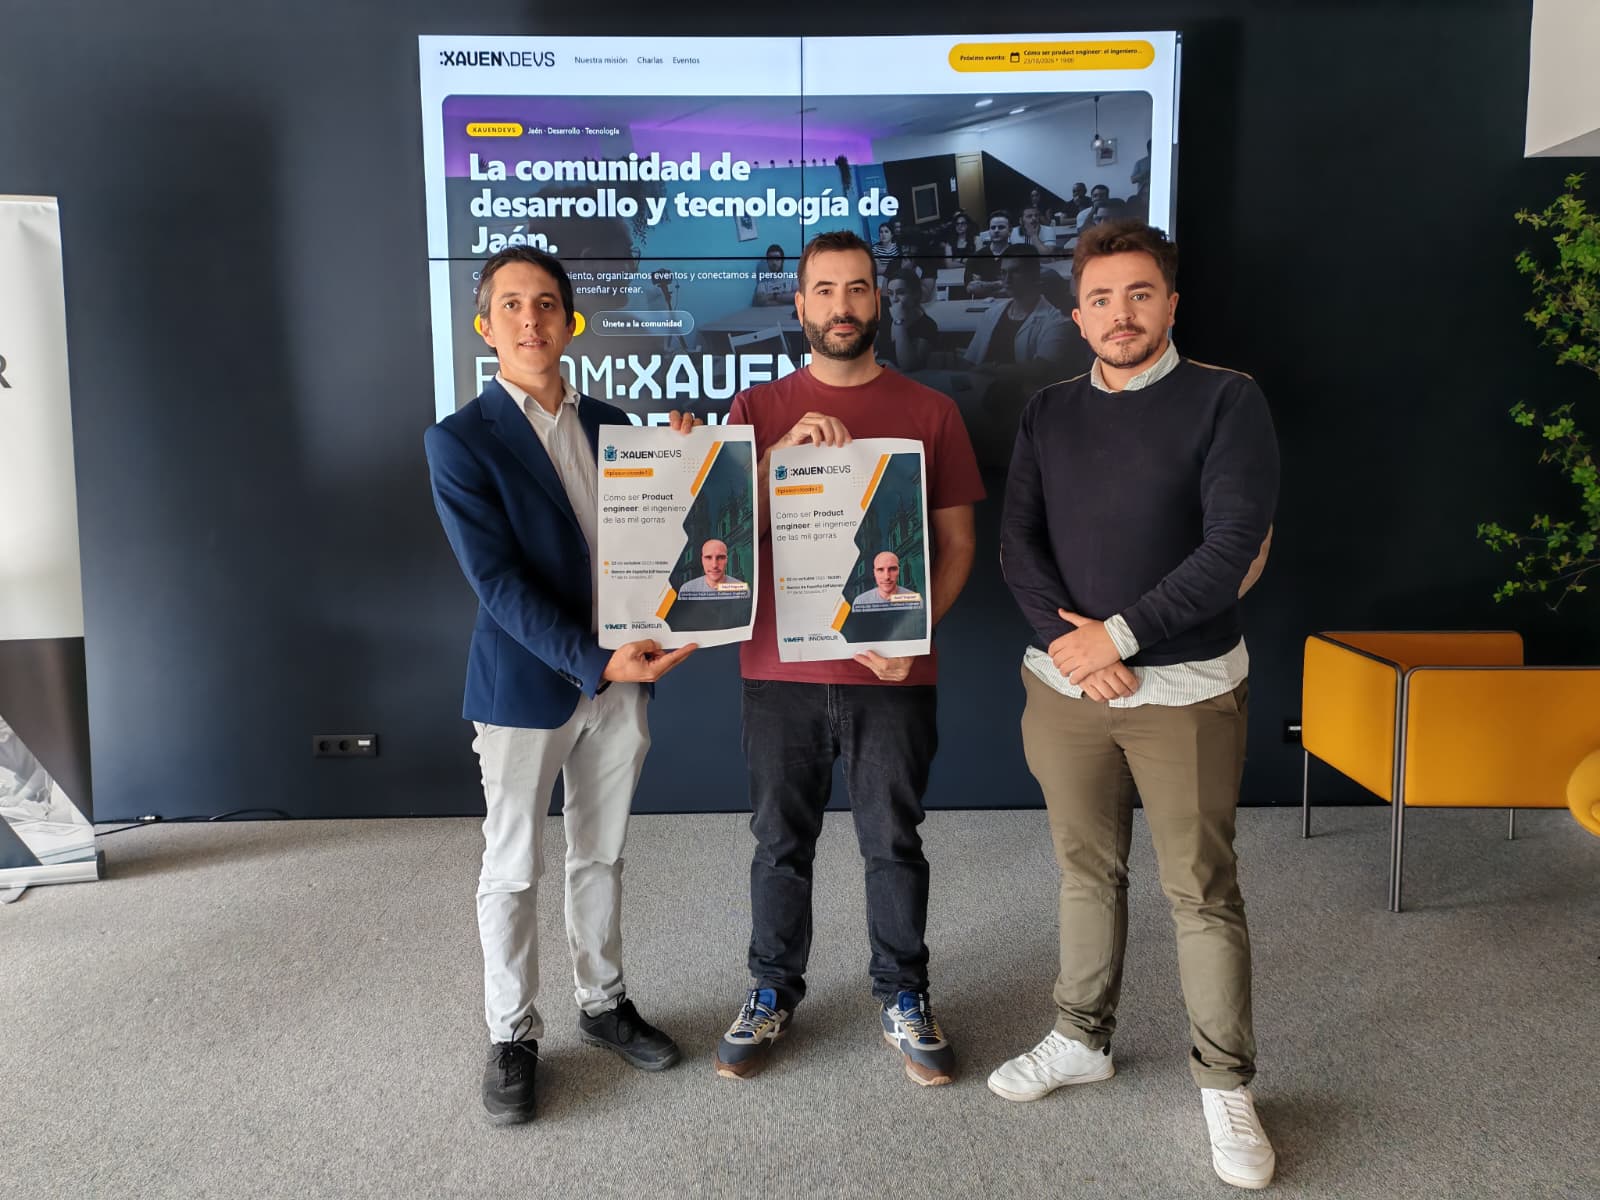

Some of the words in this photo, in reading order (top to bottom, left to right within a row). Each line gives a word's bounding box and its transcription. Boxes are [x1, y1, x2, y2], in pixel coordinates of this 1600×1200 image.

[574, 56, 603, 64] Nuestra
[604, 56, 628, 64] misión
[637, 56, 664, 64] Charlas
[672, 56, 700, 64] Eventos
[547, 127, 580, 135] Desarrollo
[585, 127, 620, 136] Tecnología
[469, 153, 506, 181] La
[515, 152, 701, 182] comunidad
[709, 152, 751, 181] de
[470, 188, 638, 218] desarrollo
[646, 196, 668, 226] y
[675, 188, 849, 225] tecnología
[858, 188, 899, 217] de
[597, 271, 652, 282] organizamos
[654, 272, 688, 280] eventos
[690, 273, 695, 282] y
[698, 271, 749, 280] conectamos
[759, 272, 798, 282] personas
[576, 285, 610, 294] enseñar
[612, 286, 618, 295] y
[619, 286, 643, 294] crear.
[602, 319, 625, 328] Únete
[632, 320, 640, 328] la
[641, 319, 682, 328] comunidad
[642, 493, 673, 501] Product
[651, 505, 687, 513] ingeniero
[813, 509, 844, 518] Product
[641, 517, 665, 525] gorras
[823, 520, 857, 529] ingeniero
[813, 533, 837, 541] gorras
